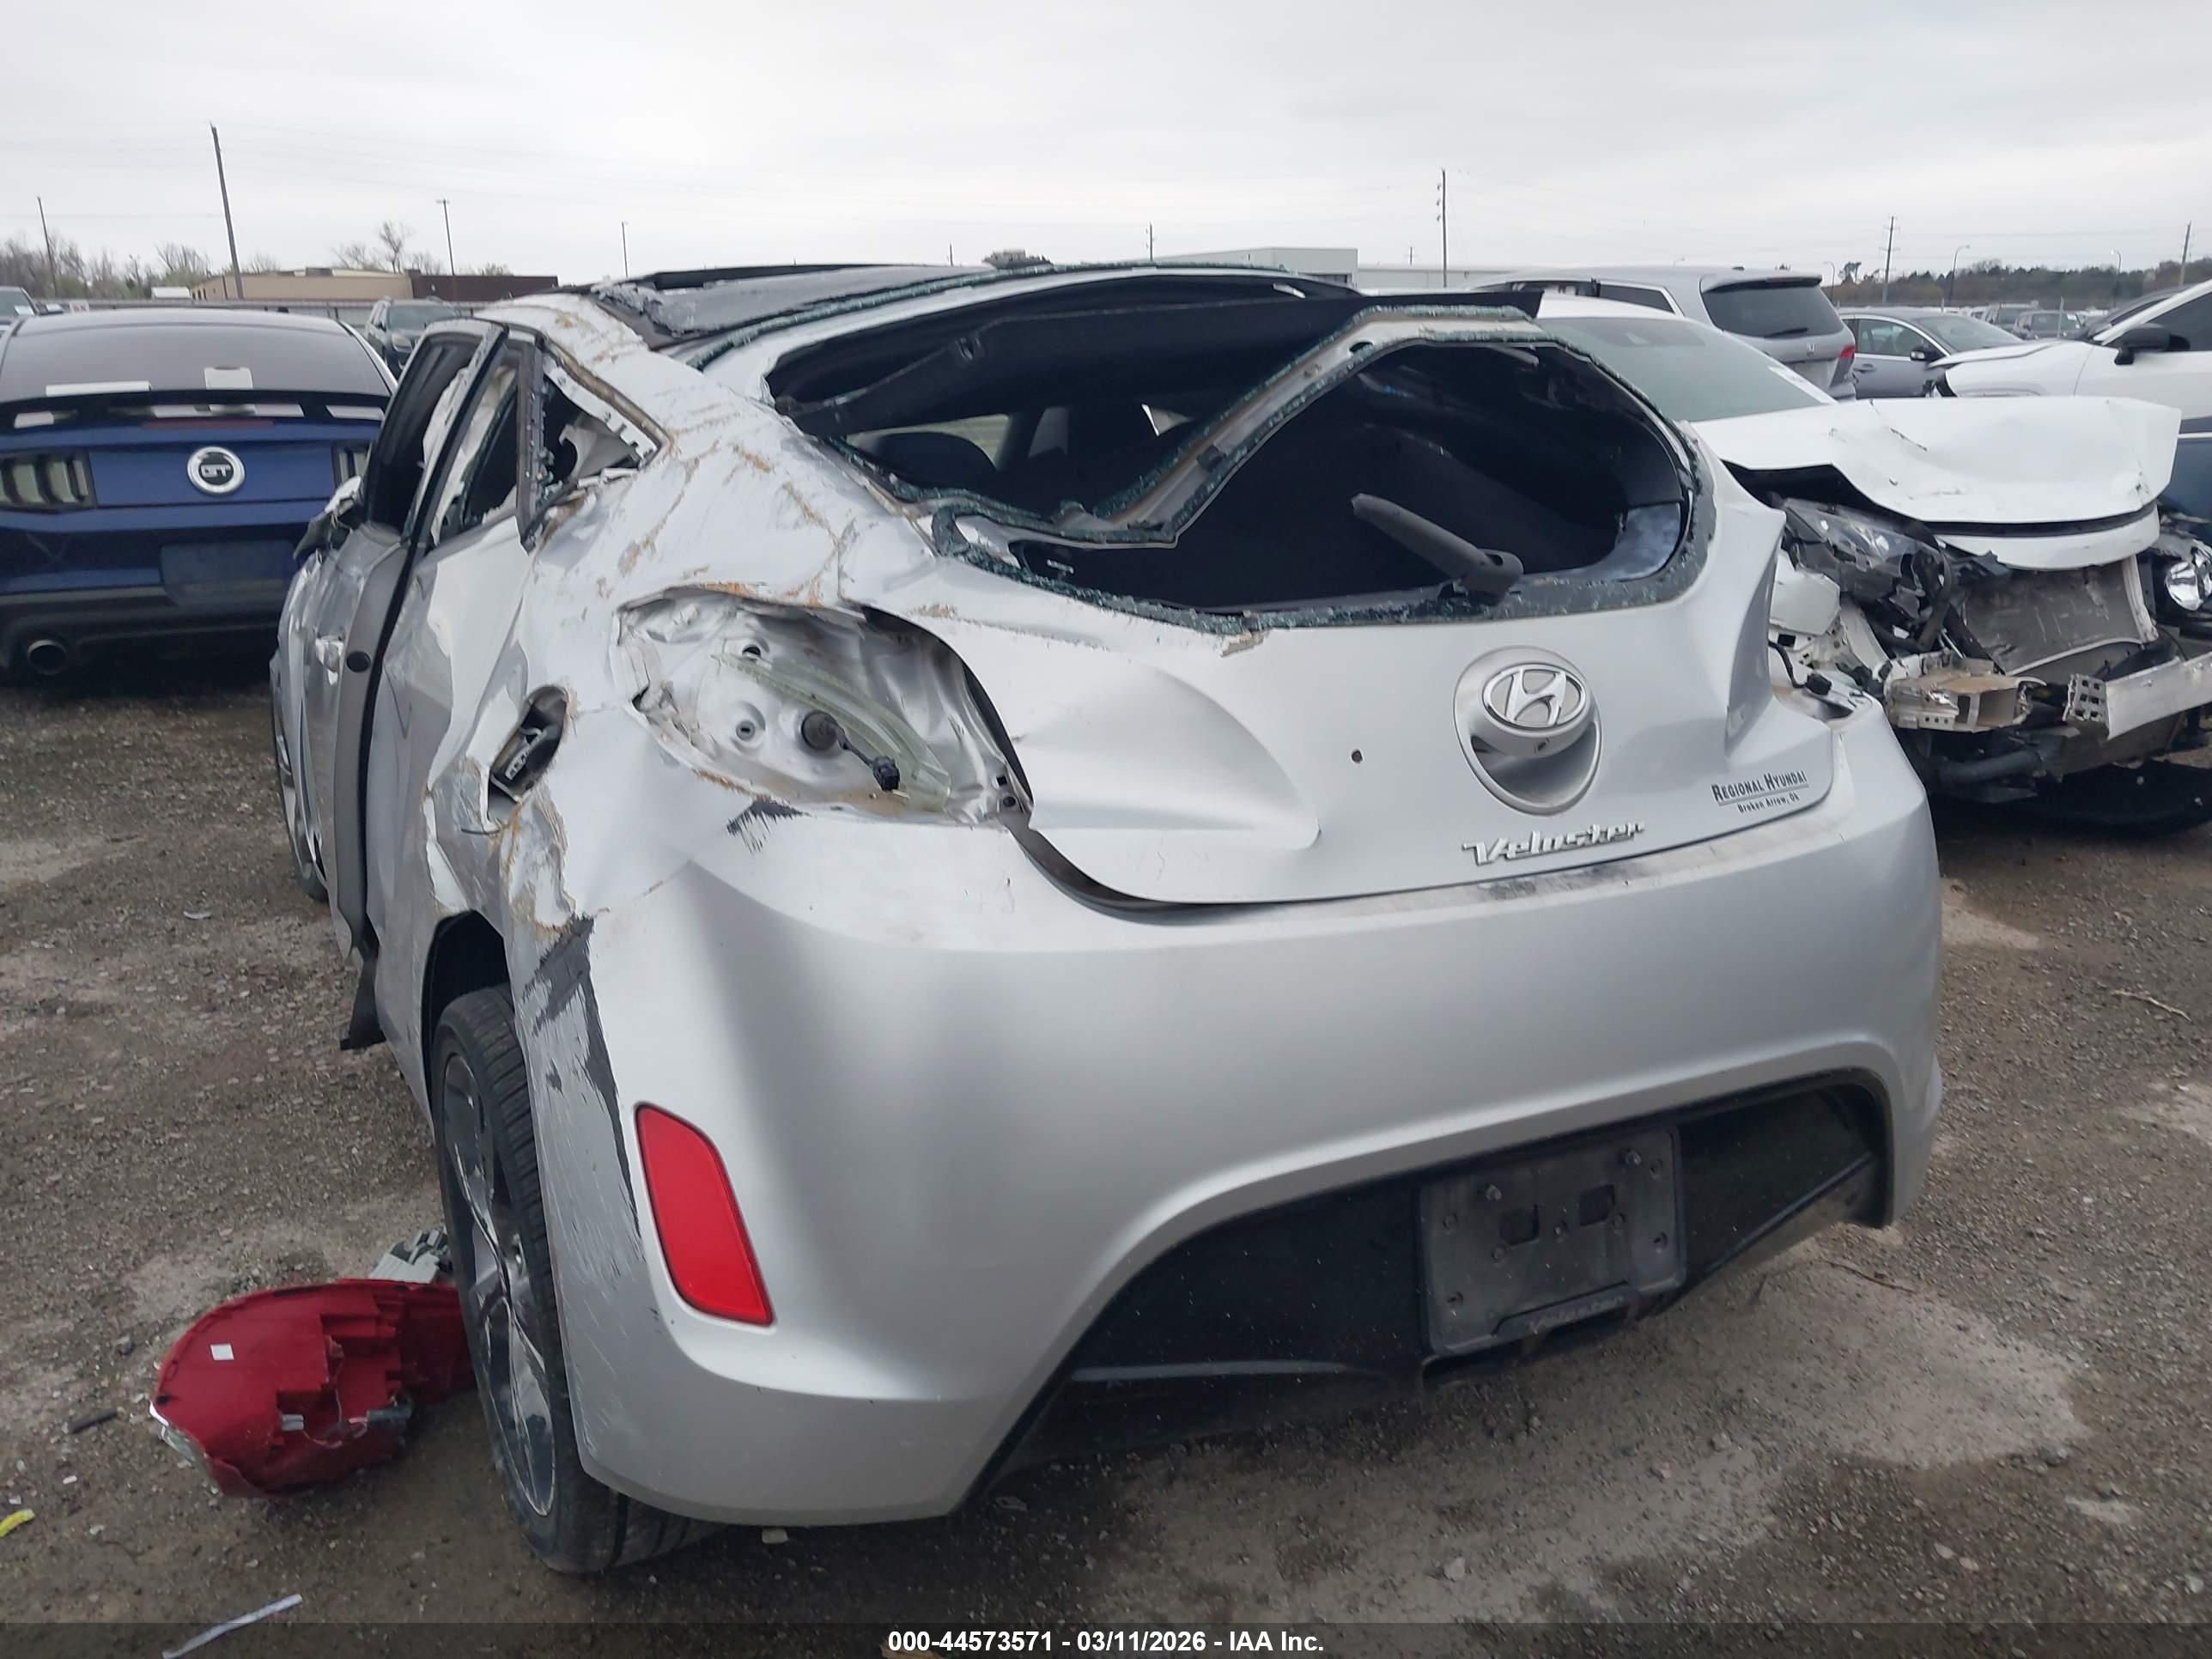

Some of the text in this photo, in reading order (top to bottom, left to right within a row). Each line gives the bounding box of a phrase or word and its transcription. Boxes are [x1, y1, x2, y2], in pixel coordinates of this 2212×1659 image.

[1711, 770, 1808, 802] REGIONAL HYUNDAI
[1462, 822, 1644, 866] Veloster
